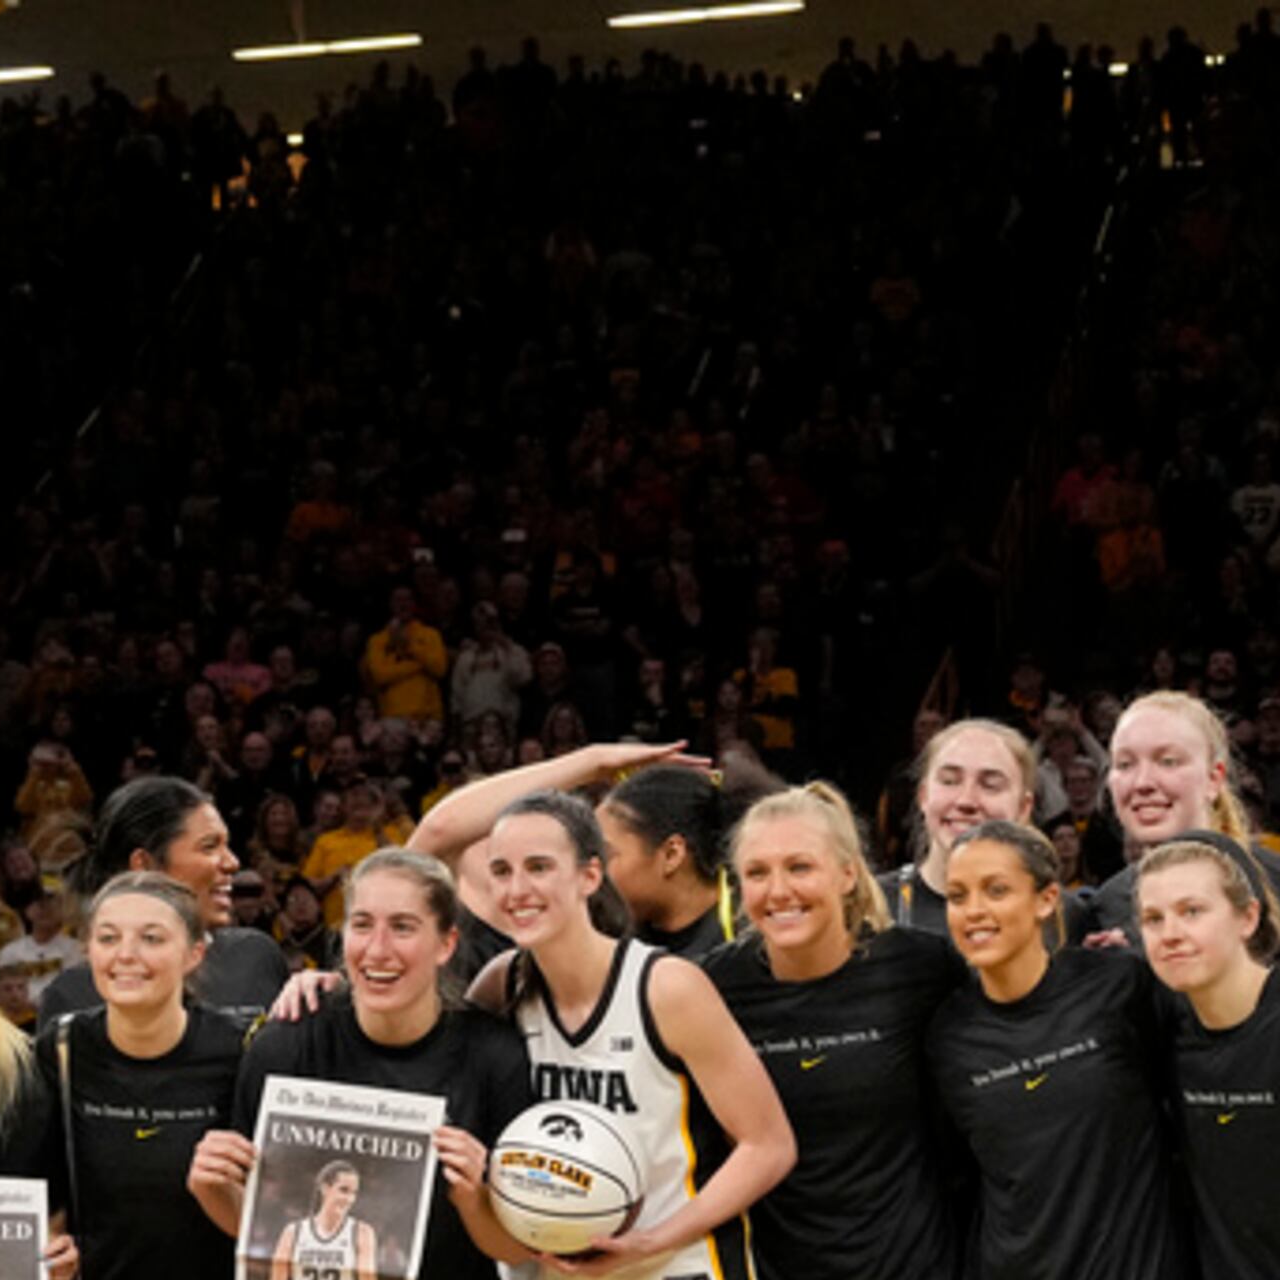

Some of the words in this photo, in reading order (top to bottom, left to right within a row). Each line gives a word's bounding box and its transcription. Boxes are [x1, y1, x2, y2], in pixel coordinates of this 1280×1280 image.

[276, 1088, 301, 1107] The
[302, 1091, 327, 1109] Des
[328, 1095, 375, 1117] Moines
[376, 1103, 429, 1124] Register
[271, 1121, 425, 1162] UNMATCHED
